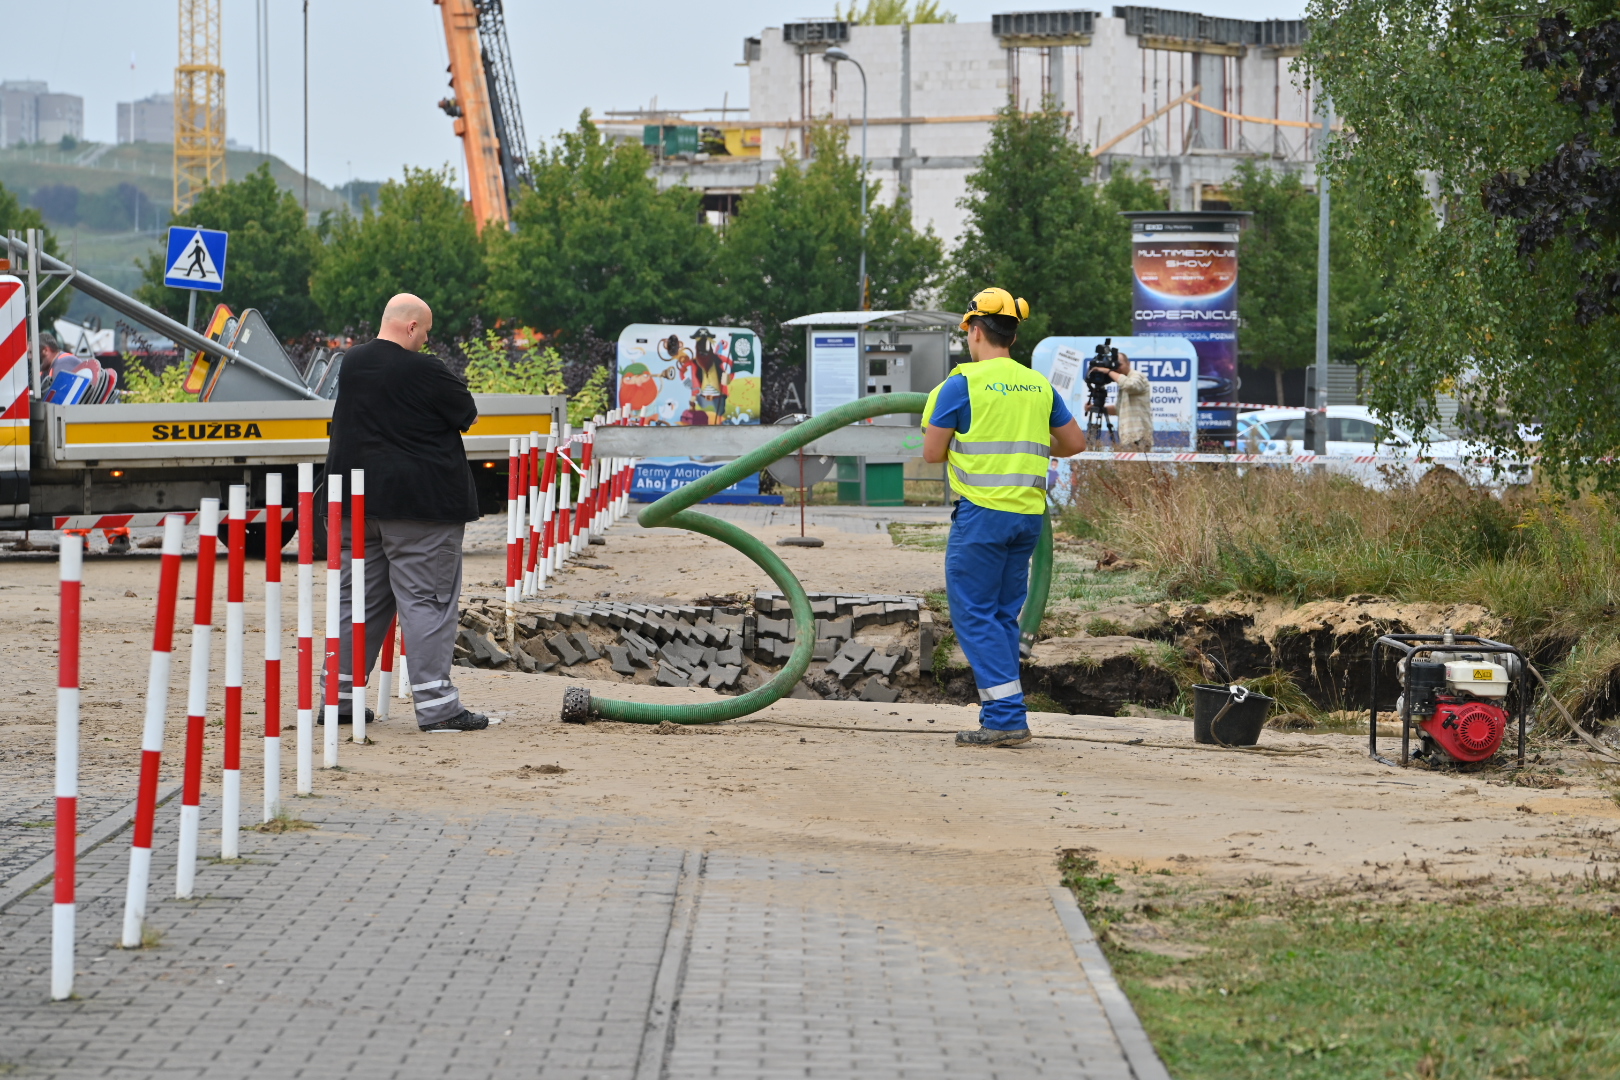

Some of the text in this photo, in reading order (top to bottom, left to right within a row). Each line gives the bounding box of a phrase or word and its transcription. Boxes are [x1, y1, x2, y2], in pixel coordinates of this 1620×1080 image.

[1138, 249, 1236, 257] MULTIMEDIALNE
[1135, 310, 1238, 320] COPERNICUS
[1152, 386, 1178, 395] SOBĄ
[152, 422, 262, 440] SŁUŻBA
[637, 467, 670, 478] Termy
[637, 479, 666, 491] Ahoj
